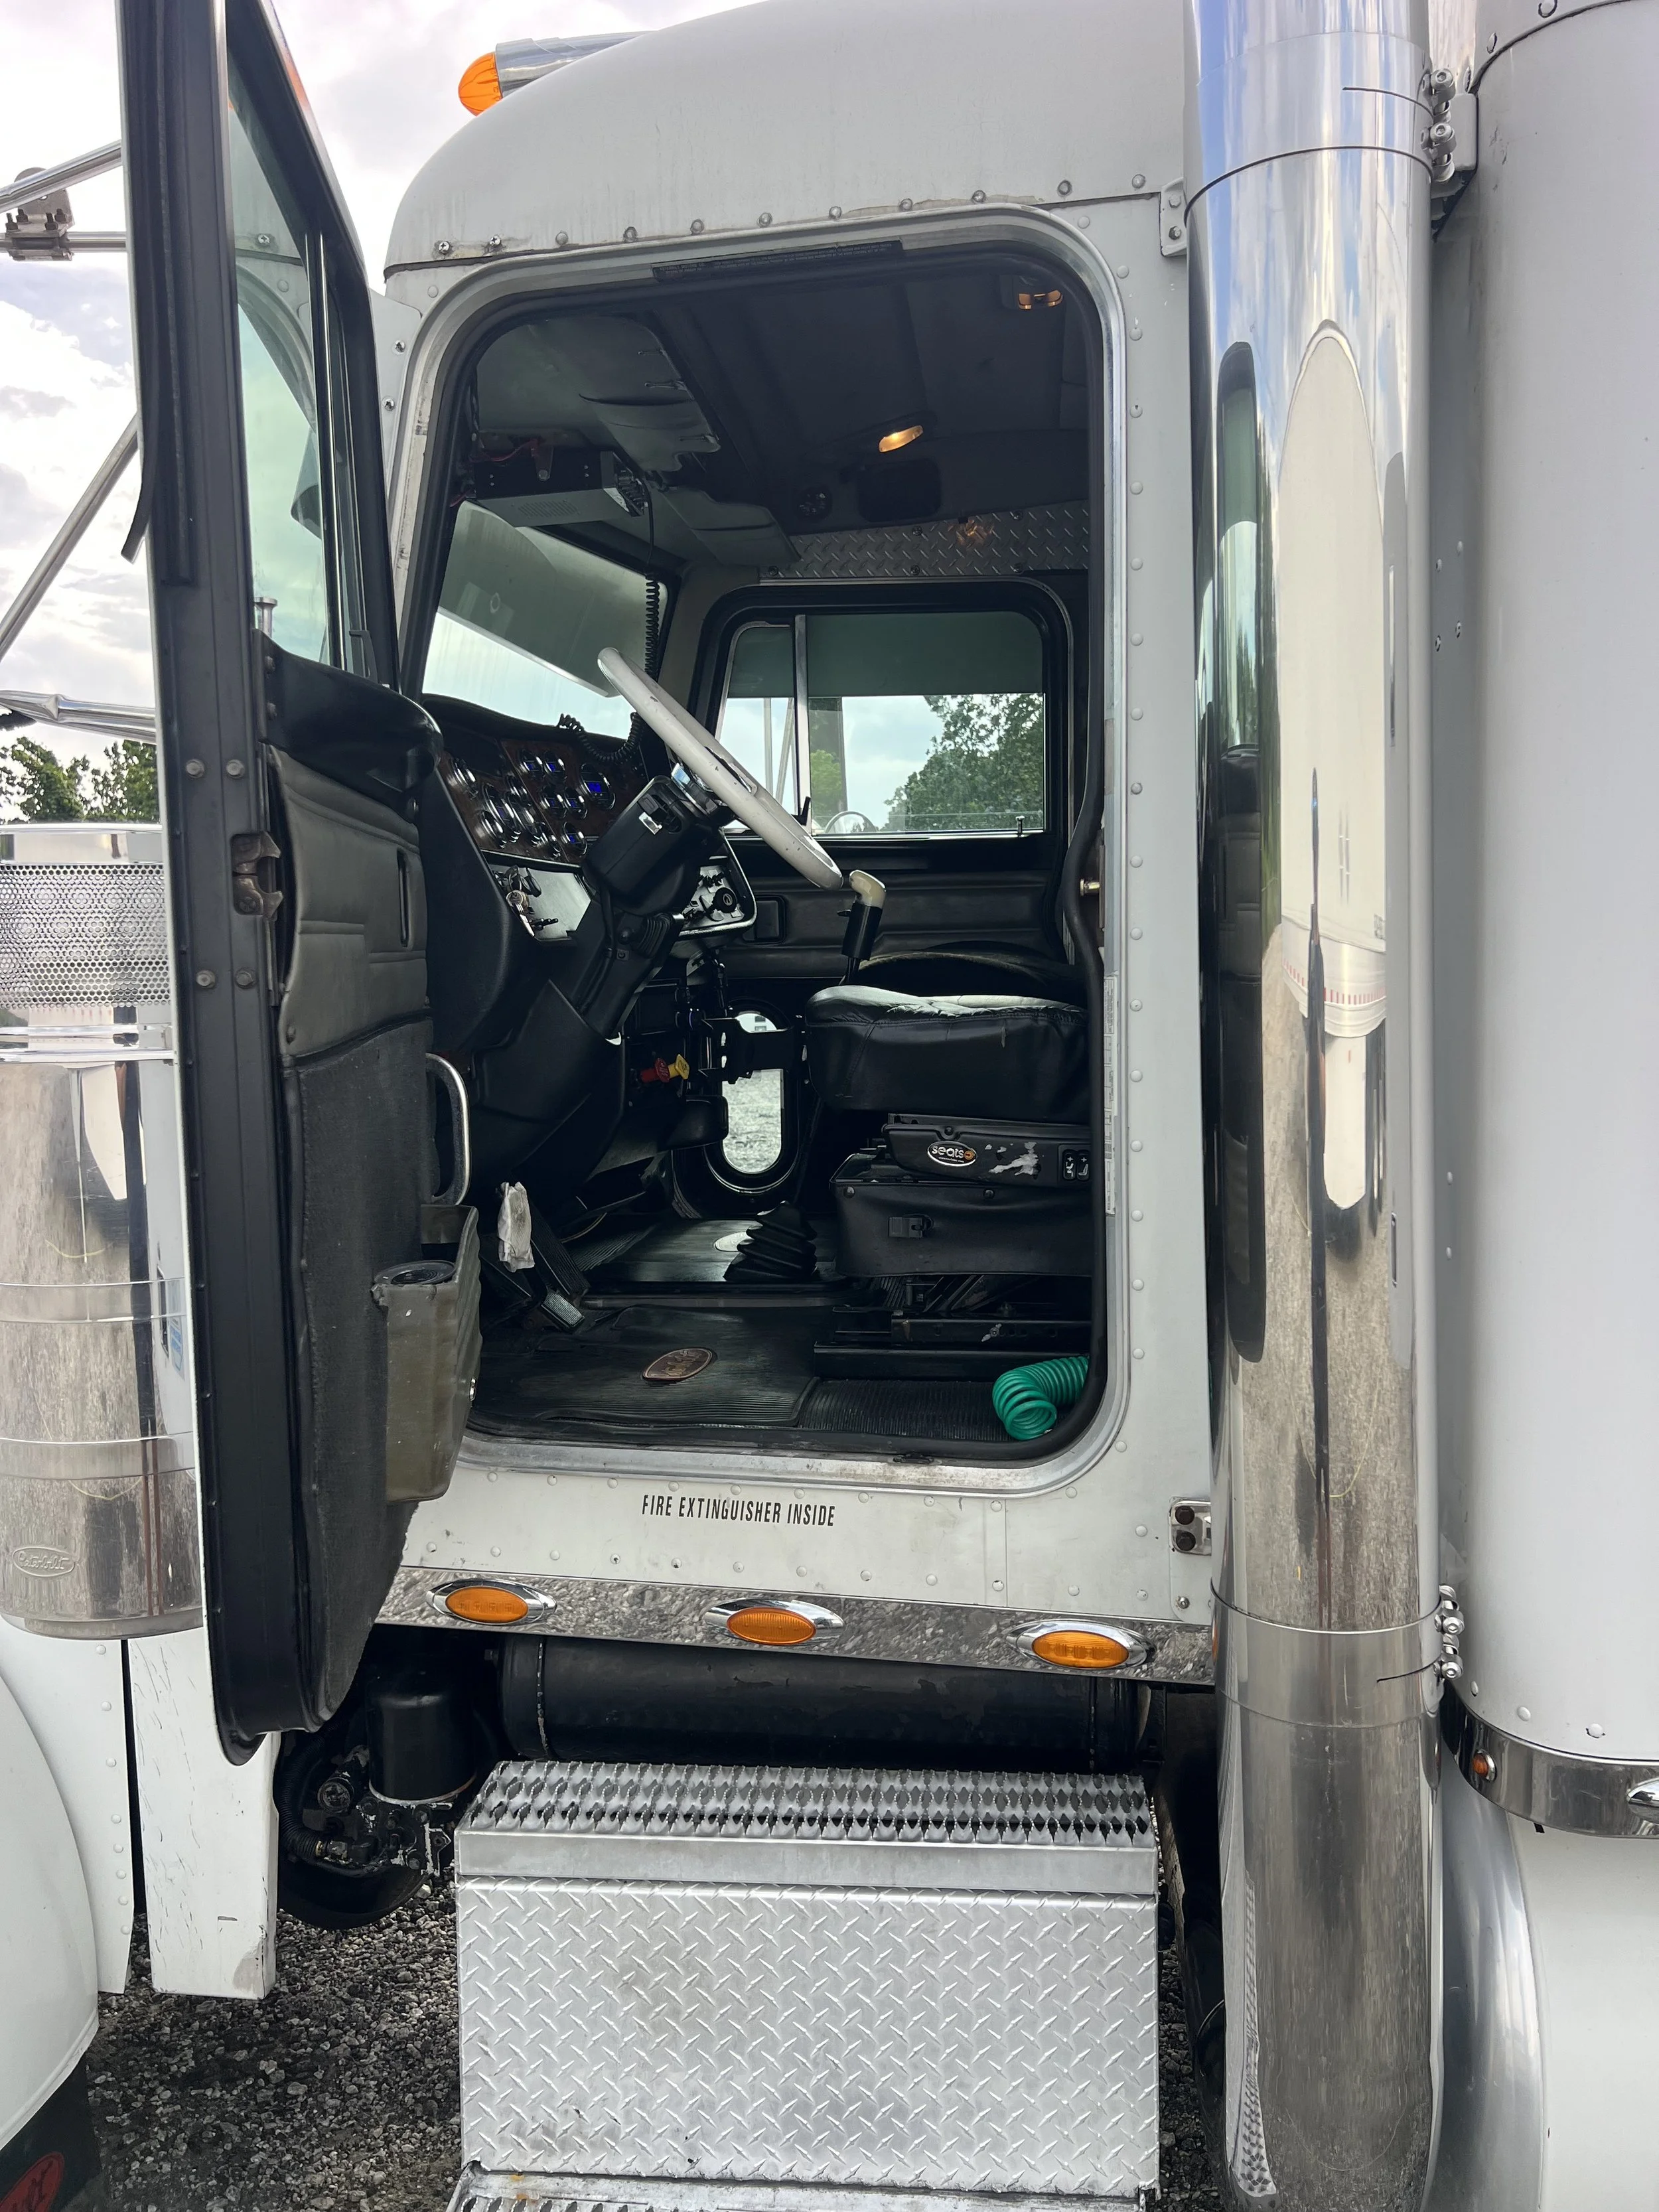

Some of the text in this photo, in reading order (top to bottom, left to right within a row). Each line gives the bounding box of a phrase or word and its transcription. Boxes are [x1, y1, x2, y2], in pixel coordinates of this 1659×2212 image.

[932, 1145, 964, 1159] seats
[642, 1495, 835, 1526] FIRE EXTINGUISHER INSIDE
